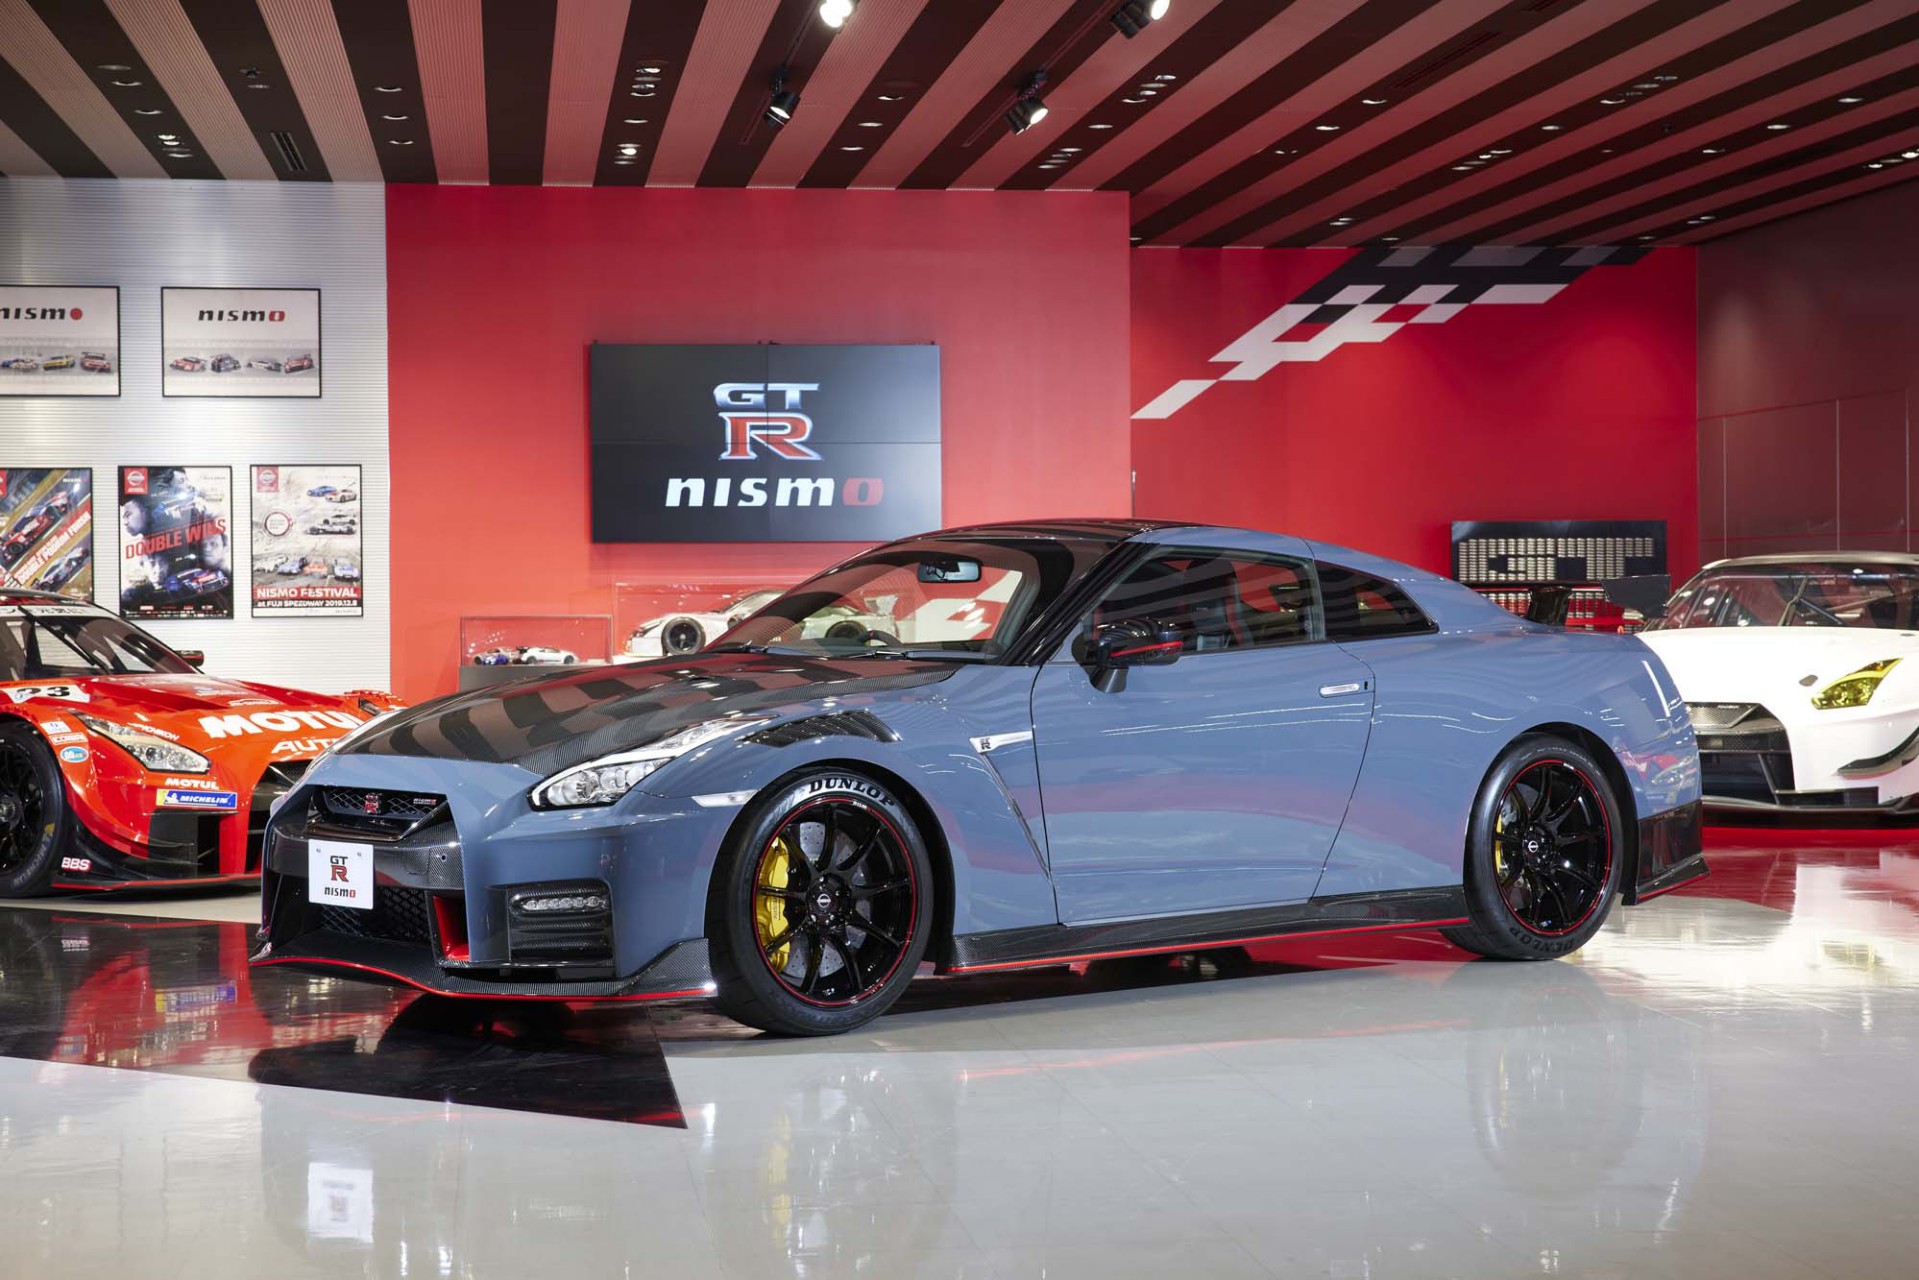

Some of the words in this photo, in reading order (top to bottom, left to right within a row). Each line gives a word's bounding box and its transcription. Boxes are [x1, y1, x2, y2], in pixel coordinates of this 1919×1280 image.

[198, 308, 286, 323] nismo
[713, 382, 820, 410] GT
[718, 411, 824, 461] R
[665, 477, 885, 507] nismo
[125, 529, 182, 560] DOUBLE
[257, 587, 298, 598] NISMO
[300, 587, 358, 598] FESTIVAL
[198, 709, 362, 739] MOTU
[271, 738, 340, 754] AUT
[164, 777, 219, 790] MOTUL
[179, 794, 229, 805] MICHELIN
[808, 777, 896, 808] DUNLOP
[61, 856, 92, 871] BBS
[330, 855, 349, 865] GT
[330, 865, 349, 882] R
[324, 886, 356, 899] nismo
